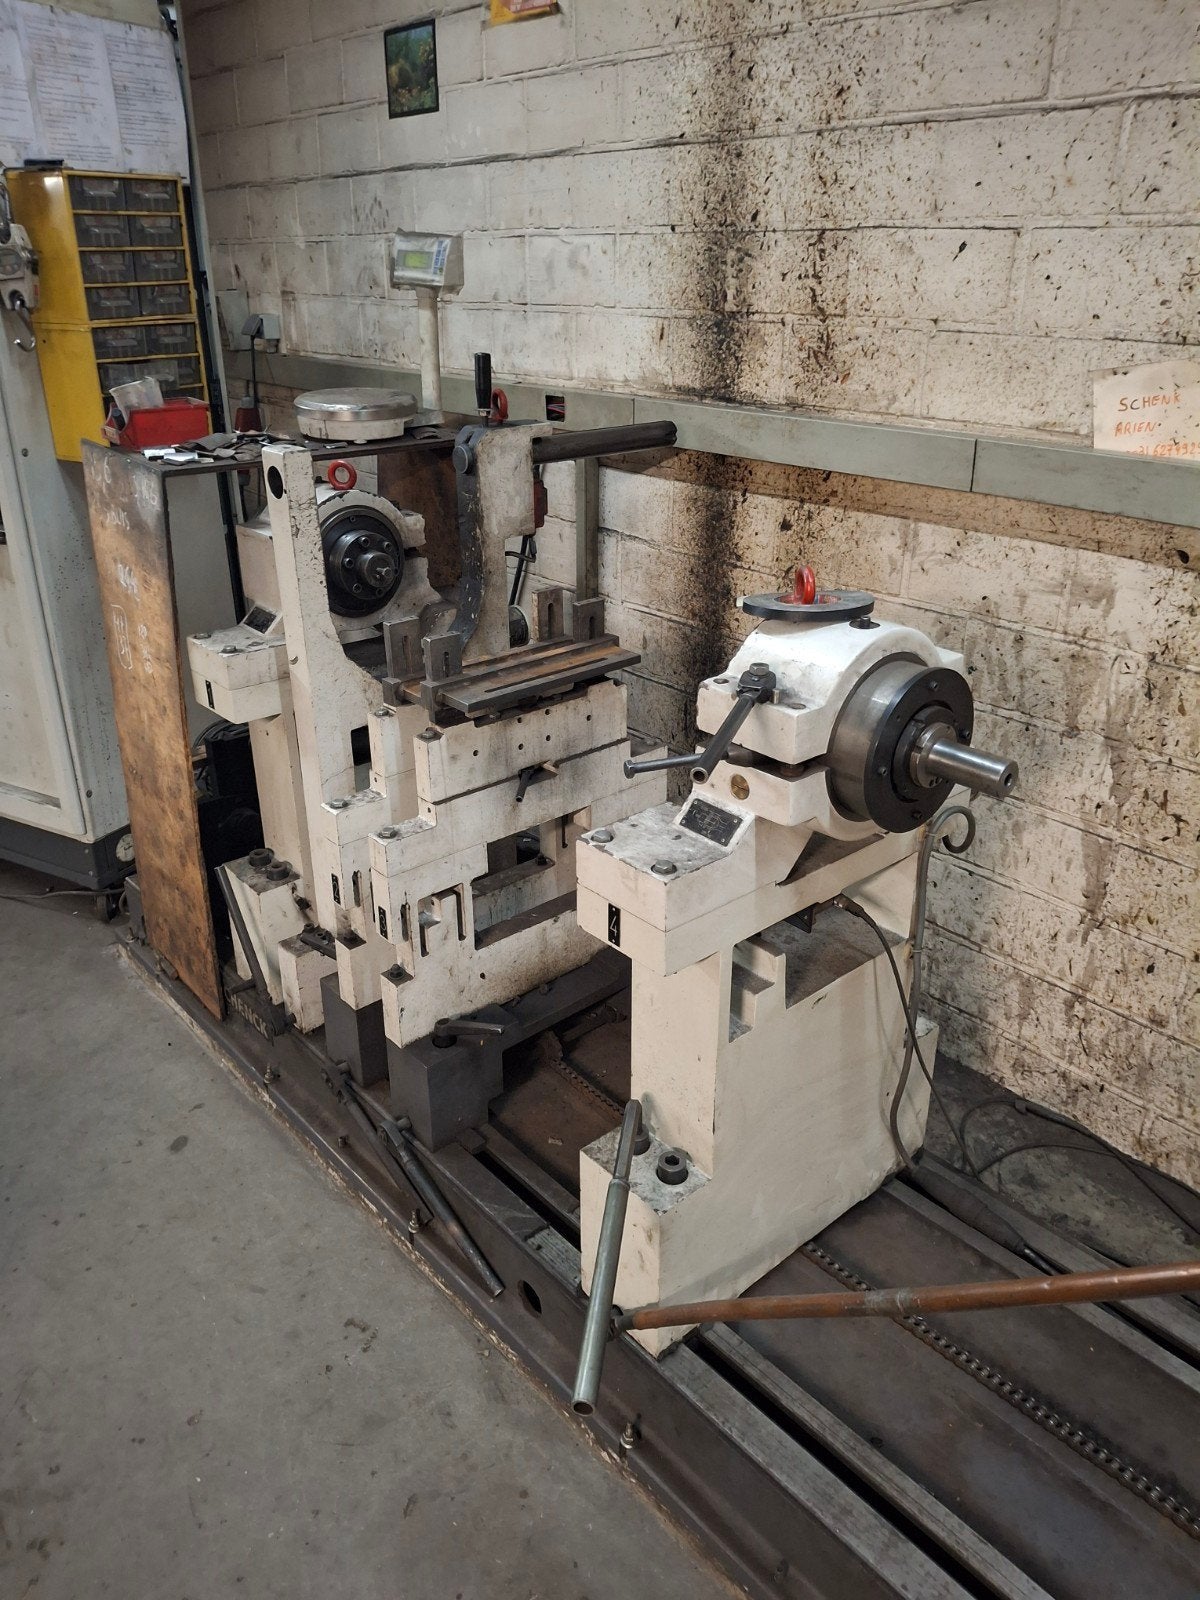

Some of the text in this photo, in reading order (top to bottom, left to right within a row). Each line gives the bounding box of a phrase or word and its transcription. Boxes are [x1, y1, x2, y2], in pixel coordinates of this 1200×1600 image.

[1118, 392, 1180, 412] SCHENK
[1114, 421, 1157, 437] ARIEN
[332, 881, 339, 898] 2
[379, 914, 387, 931] 3
[609, 915, 618, 937] 4
